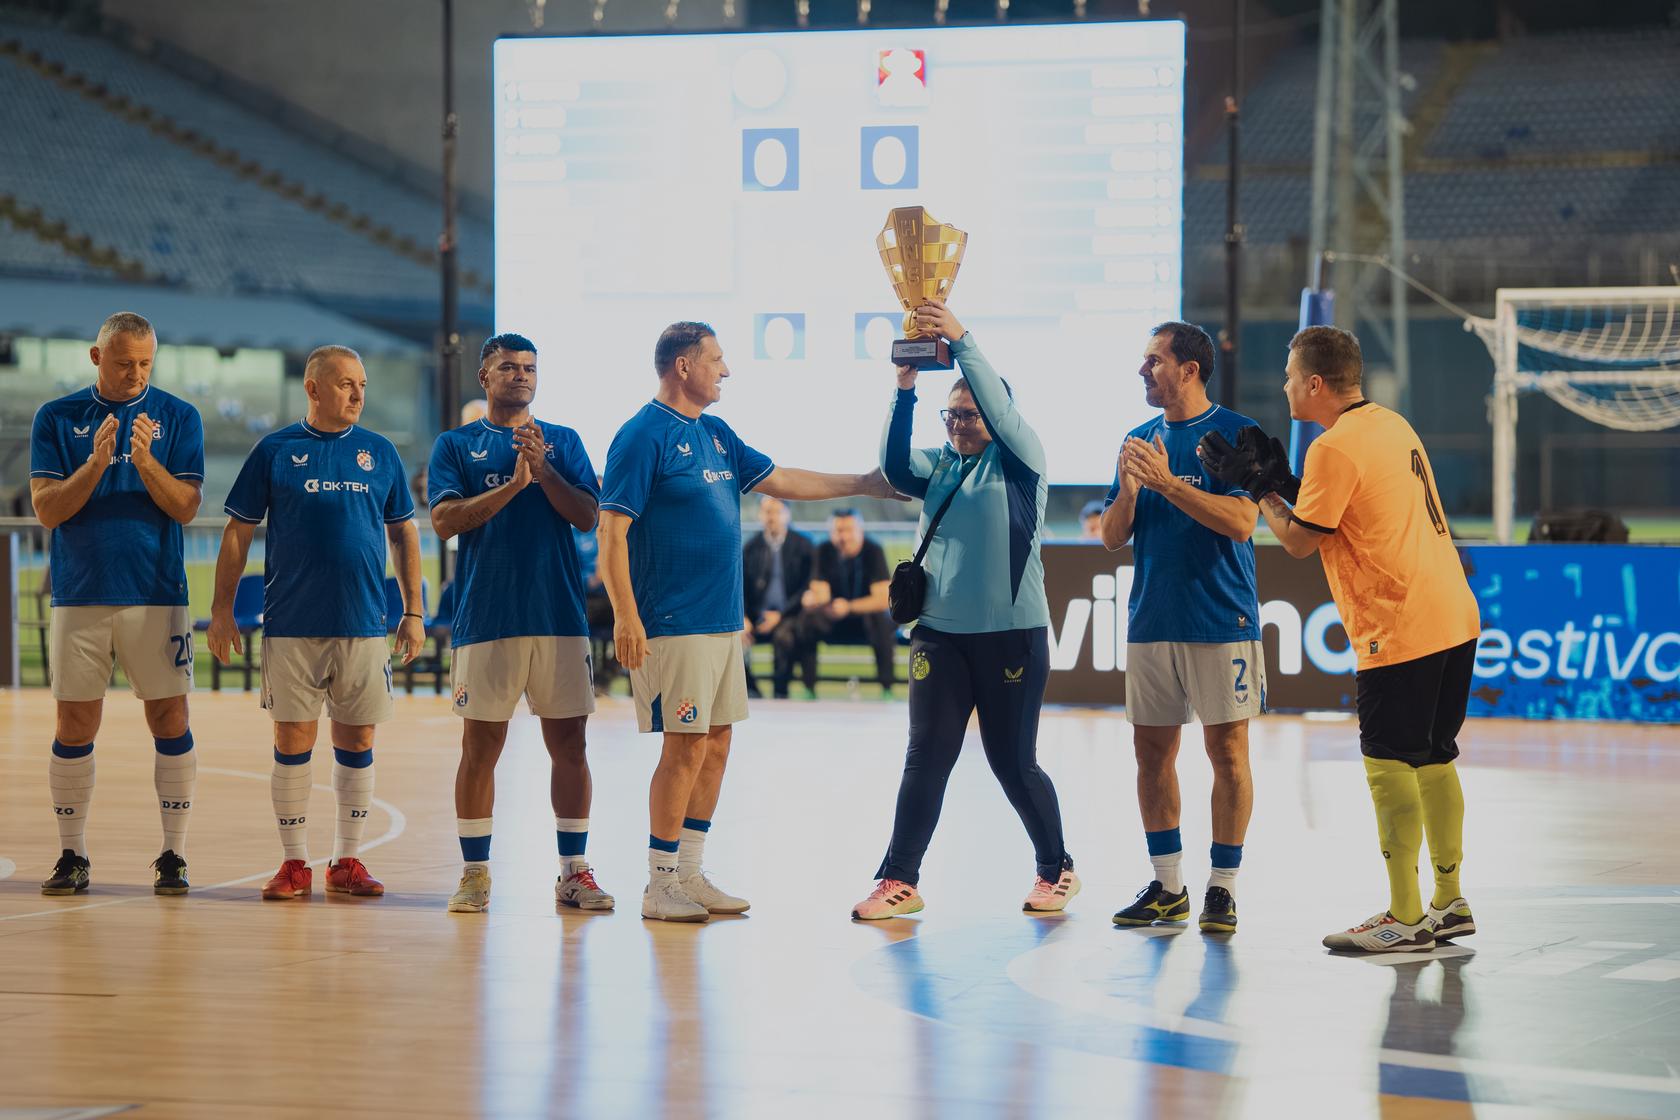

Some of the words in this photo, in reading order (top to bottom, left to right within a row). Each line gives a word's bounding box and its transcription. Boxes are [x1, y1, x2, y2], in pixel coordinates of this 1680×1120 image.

[1410, 448, 1447, 536] 1
[171, 631, 193, 667] 20
[1232, 658, 1248, 692] 2
